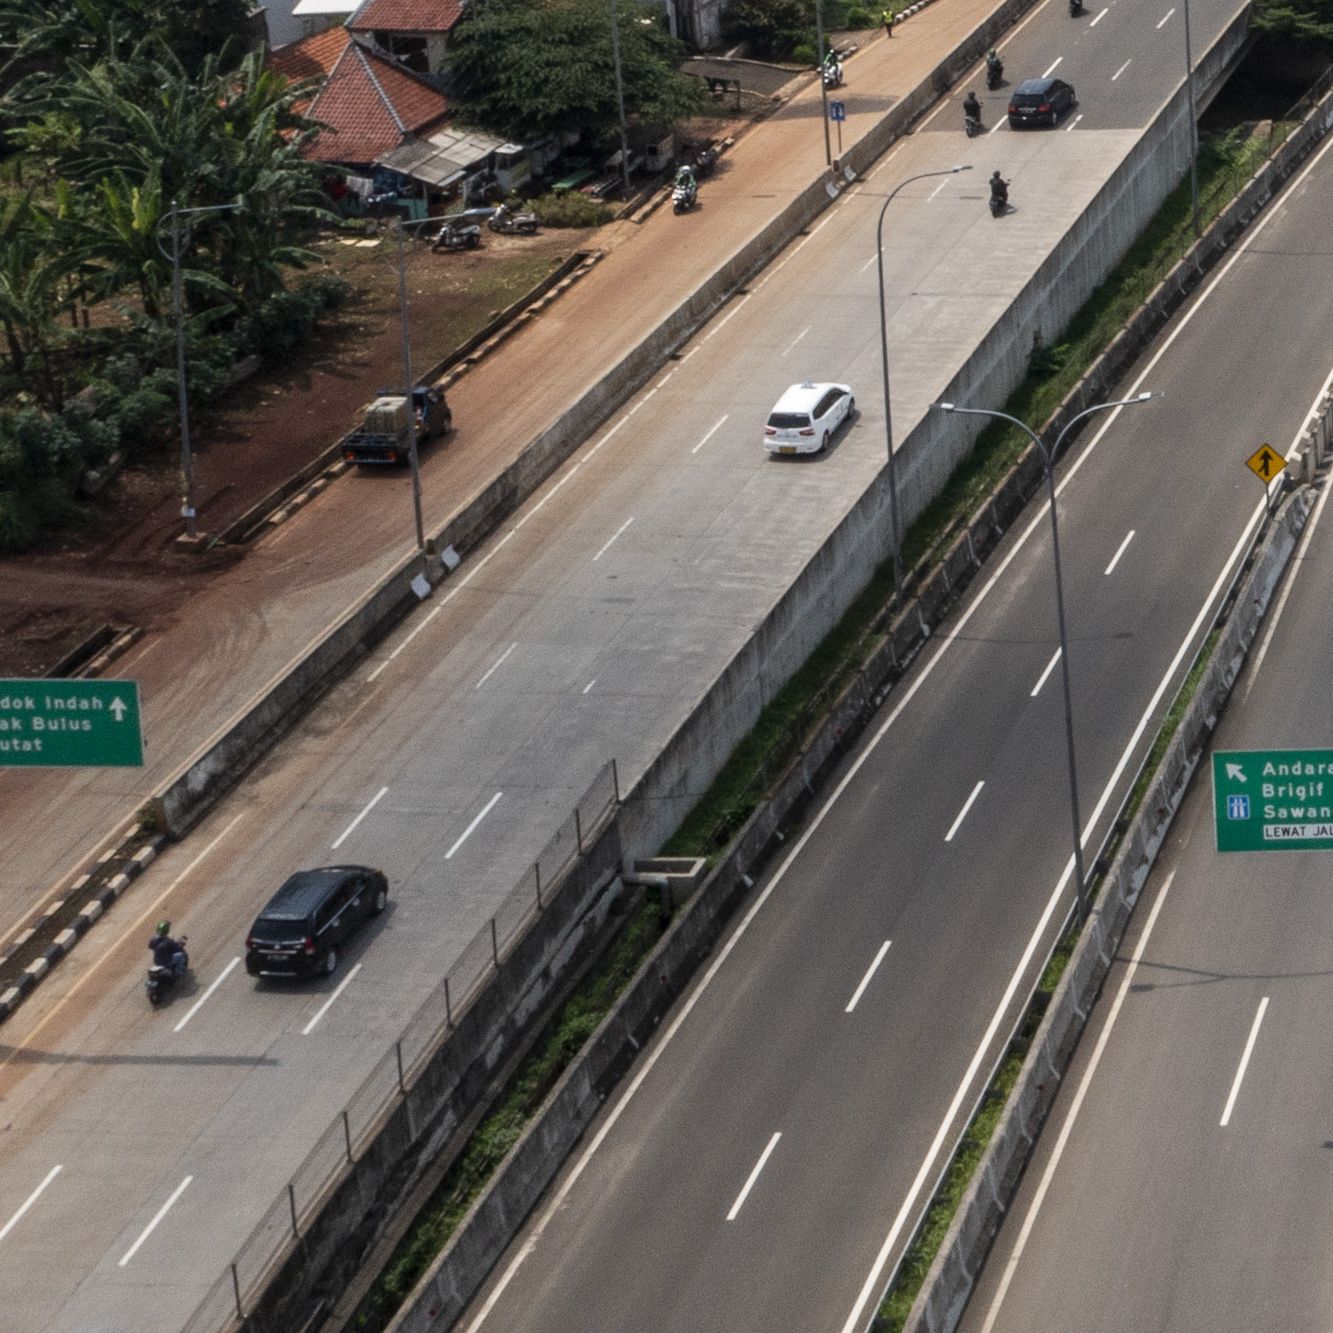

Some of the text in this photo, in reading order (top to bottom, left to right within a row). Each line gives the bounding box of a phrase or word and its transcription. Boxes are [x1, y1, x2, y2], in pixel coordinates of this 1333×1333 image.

[46, 696, 103, 710] Indah
[32, 717, 92, 731] Bulus
[1262, 782, 1324, 801] Brigif
[1265, 826, 1306, 837] LEWAT
